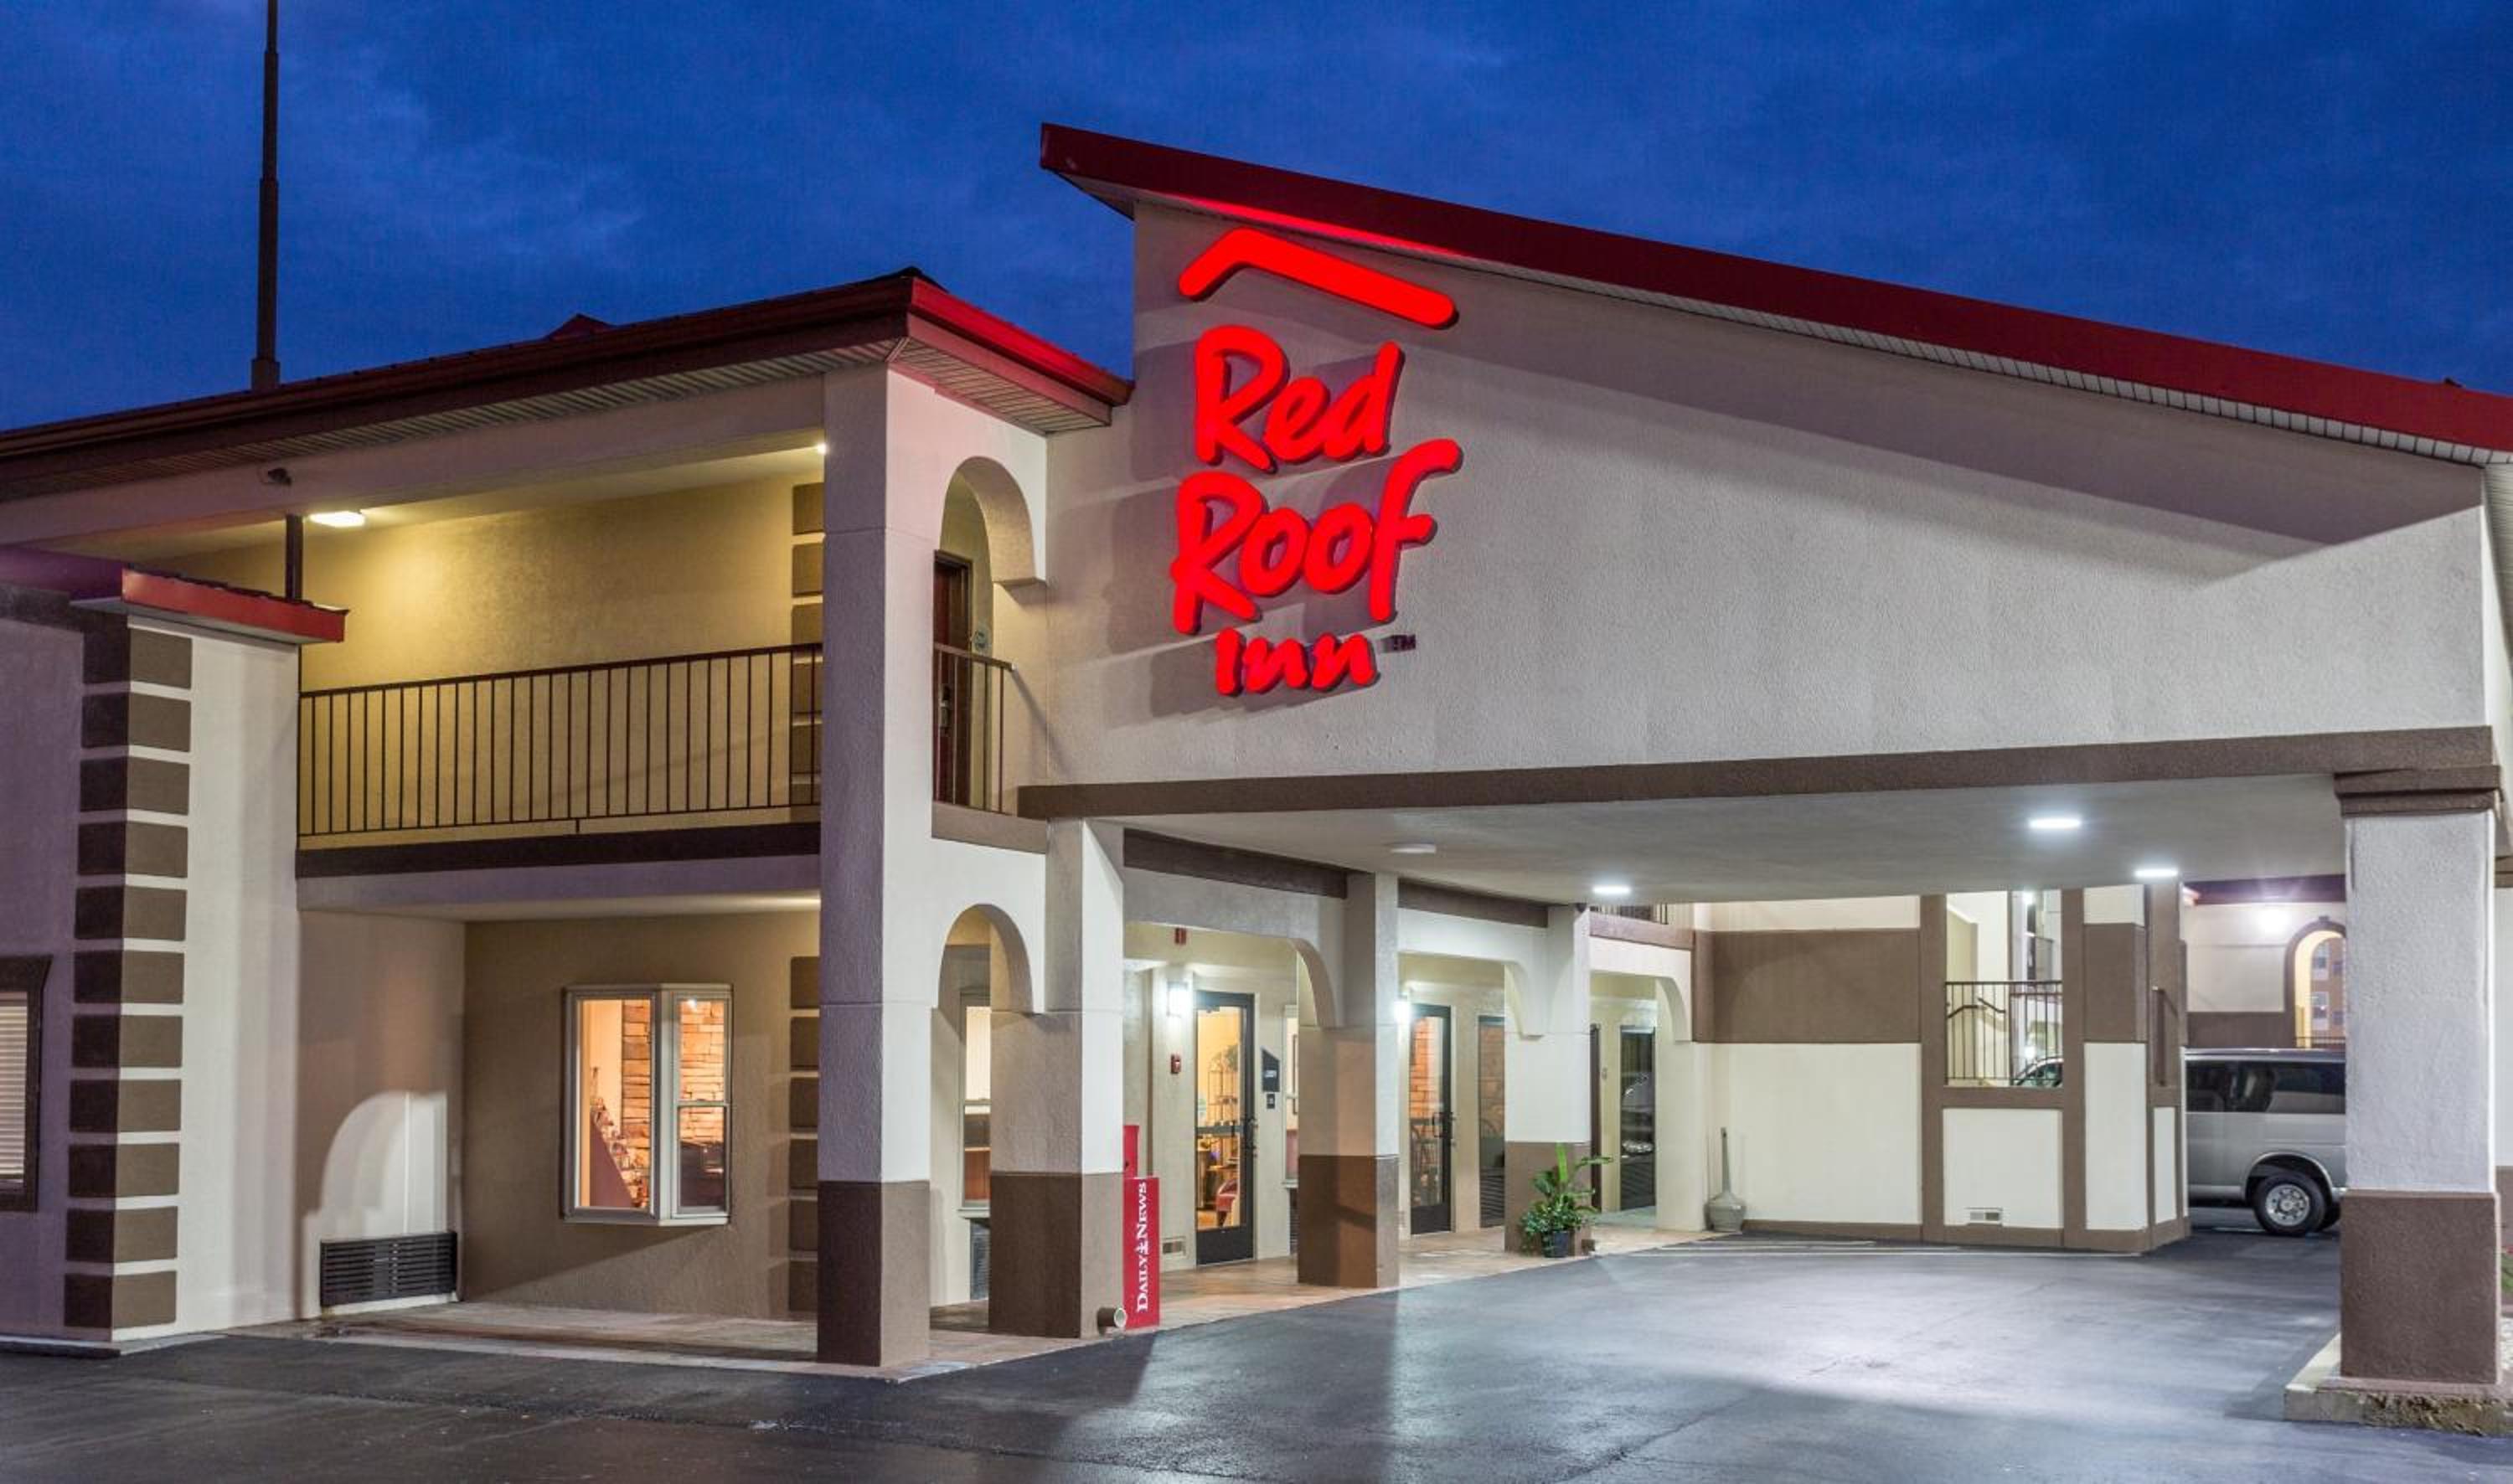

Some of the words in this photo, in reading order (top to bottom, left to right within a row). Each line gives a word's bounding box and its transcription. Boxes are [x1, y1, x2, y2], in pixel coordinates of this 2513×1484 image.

[1195, 325, 1400, 471] Red
[1169, 438, 1460, 634] Roof
[1215, 626, 1375, 694] Inn
[1136, 1182, 1149, 1239] NEWS
[1136, 1255, 1149, 1312] DAILY
